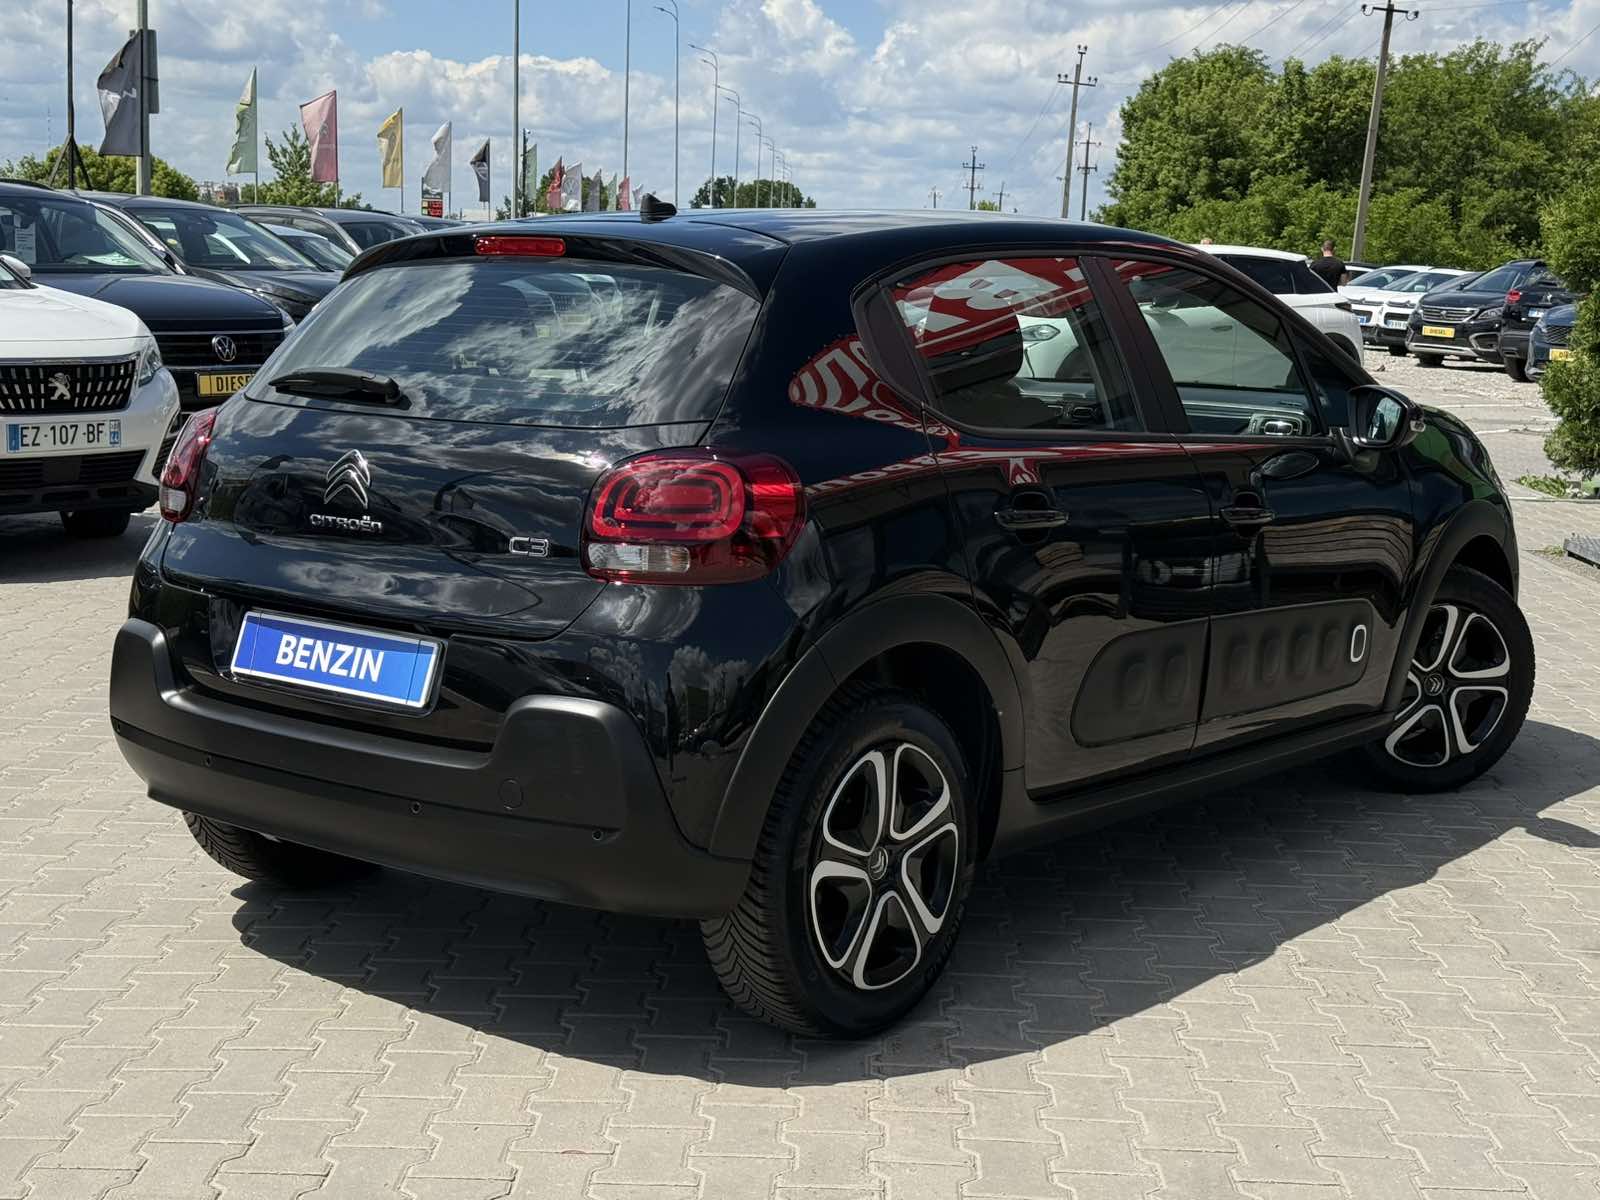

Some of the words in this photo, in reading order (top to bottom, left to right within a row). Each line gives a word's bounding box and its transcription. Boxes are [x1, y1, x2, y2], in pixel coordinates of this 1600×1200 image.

[215, 375, 253, 392] DIESE
[509, 536, 549, 557] C3
[276, 634, 385, 683] BENZIN
